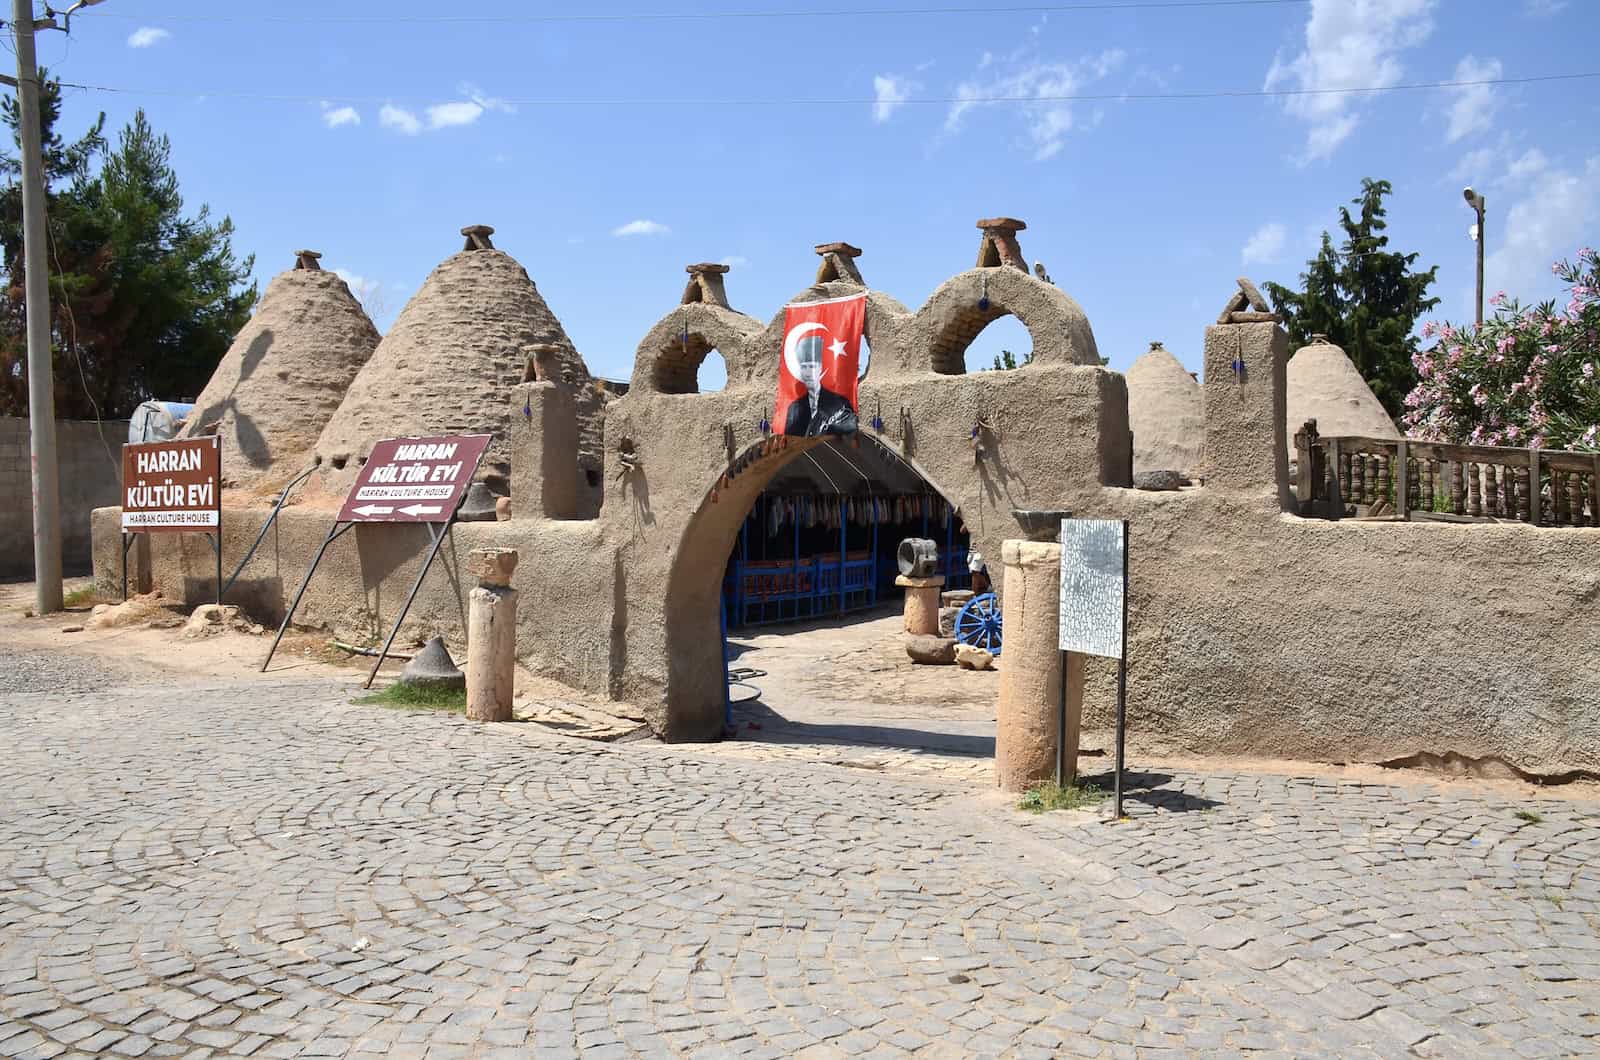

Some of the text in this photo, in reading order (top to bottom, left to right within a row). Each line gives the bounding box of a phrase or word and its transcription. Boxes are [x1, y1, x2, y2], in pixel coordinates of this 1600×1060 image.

[138, 448, 201, 473] HARRAN
[393, 443, 458, 461] HARRAN
[368, 460, 463, 482] KÜLTÜR EVİ
[127, 476, 213, 507] KÜLTÜR EVİ
[360, 487, 449, 497] HARRAN CULTURE HOUSE
[130, 513, 210, 523] HARRAN CULTURE HOUSE
